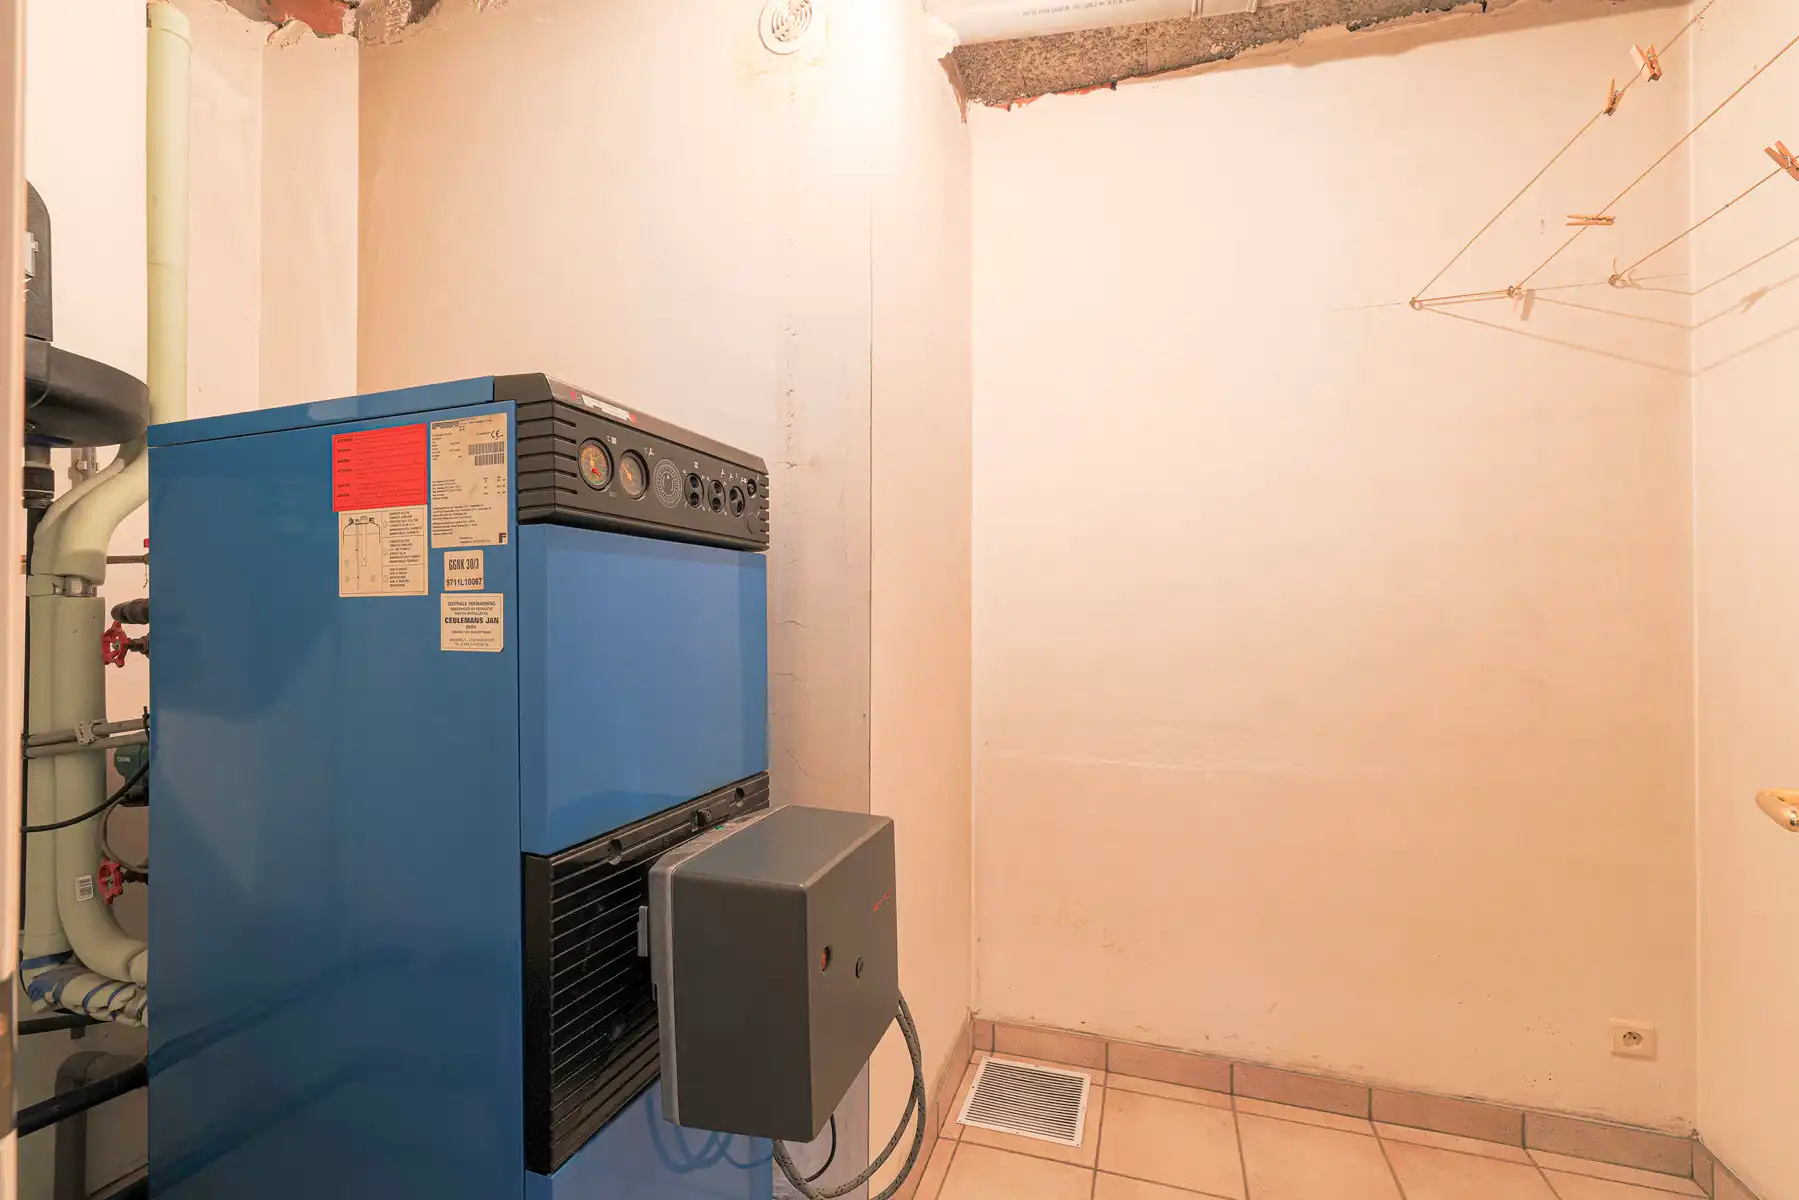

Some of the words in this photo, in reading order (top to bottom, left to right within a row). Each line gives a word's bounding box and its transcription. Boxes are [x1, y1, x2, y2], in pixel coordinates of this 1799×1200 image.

[449, 559, 465, 570] GGNK
[466, 558, 479, 570] 30/3
[446, 578, 482, 586] 9711L10067
